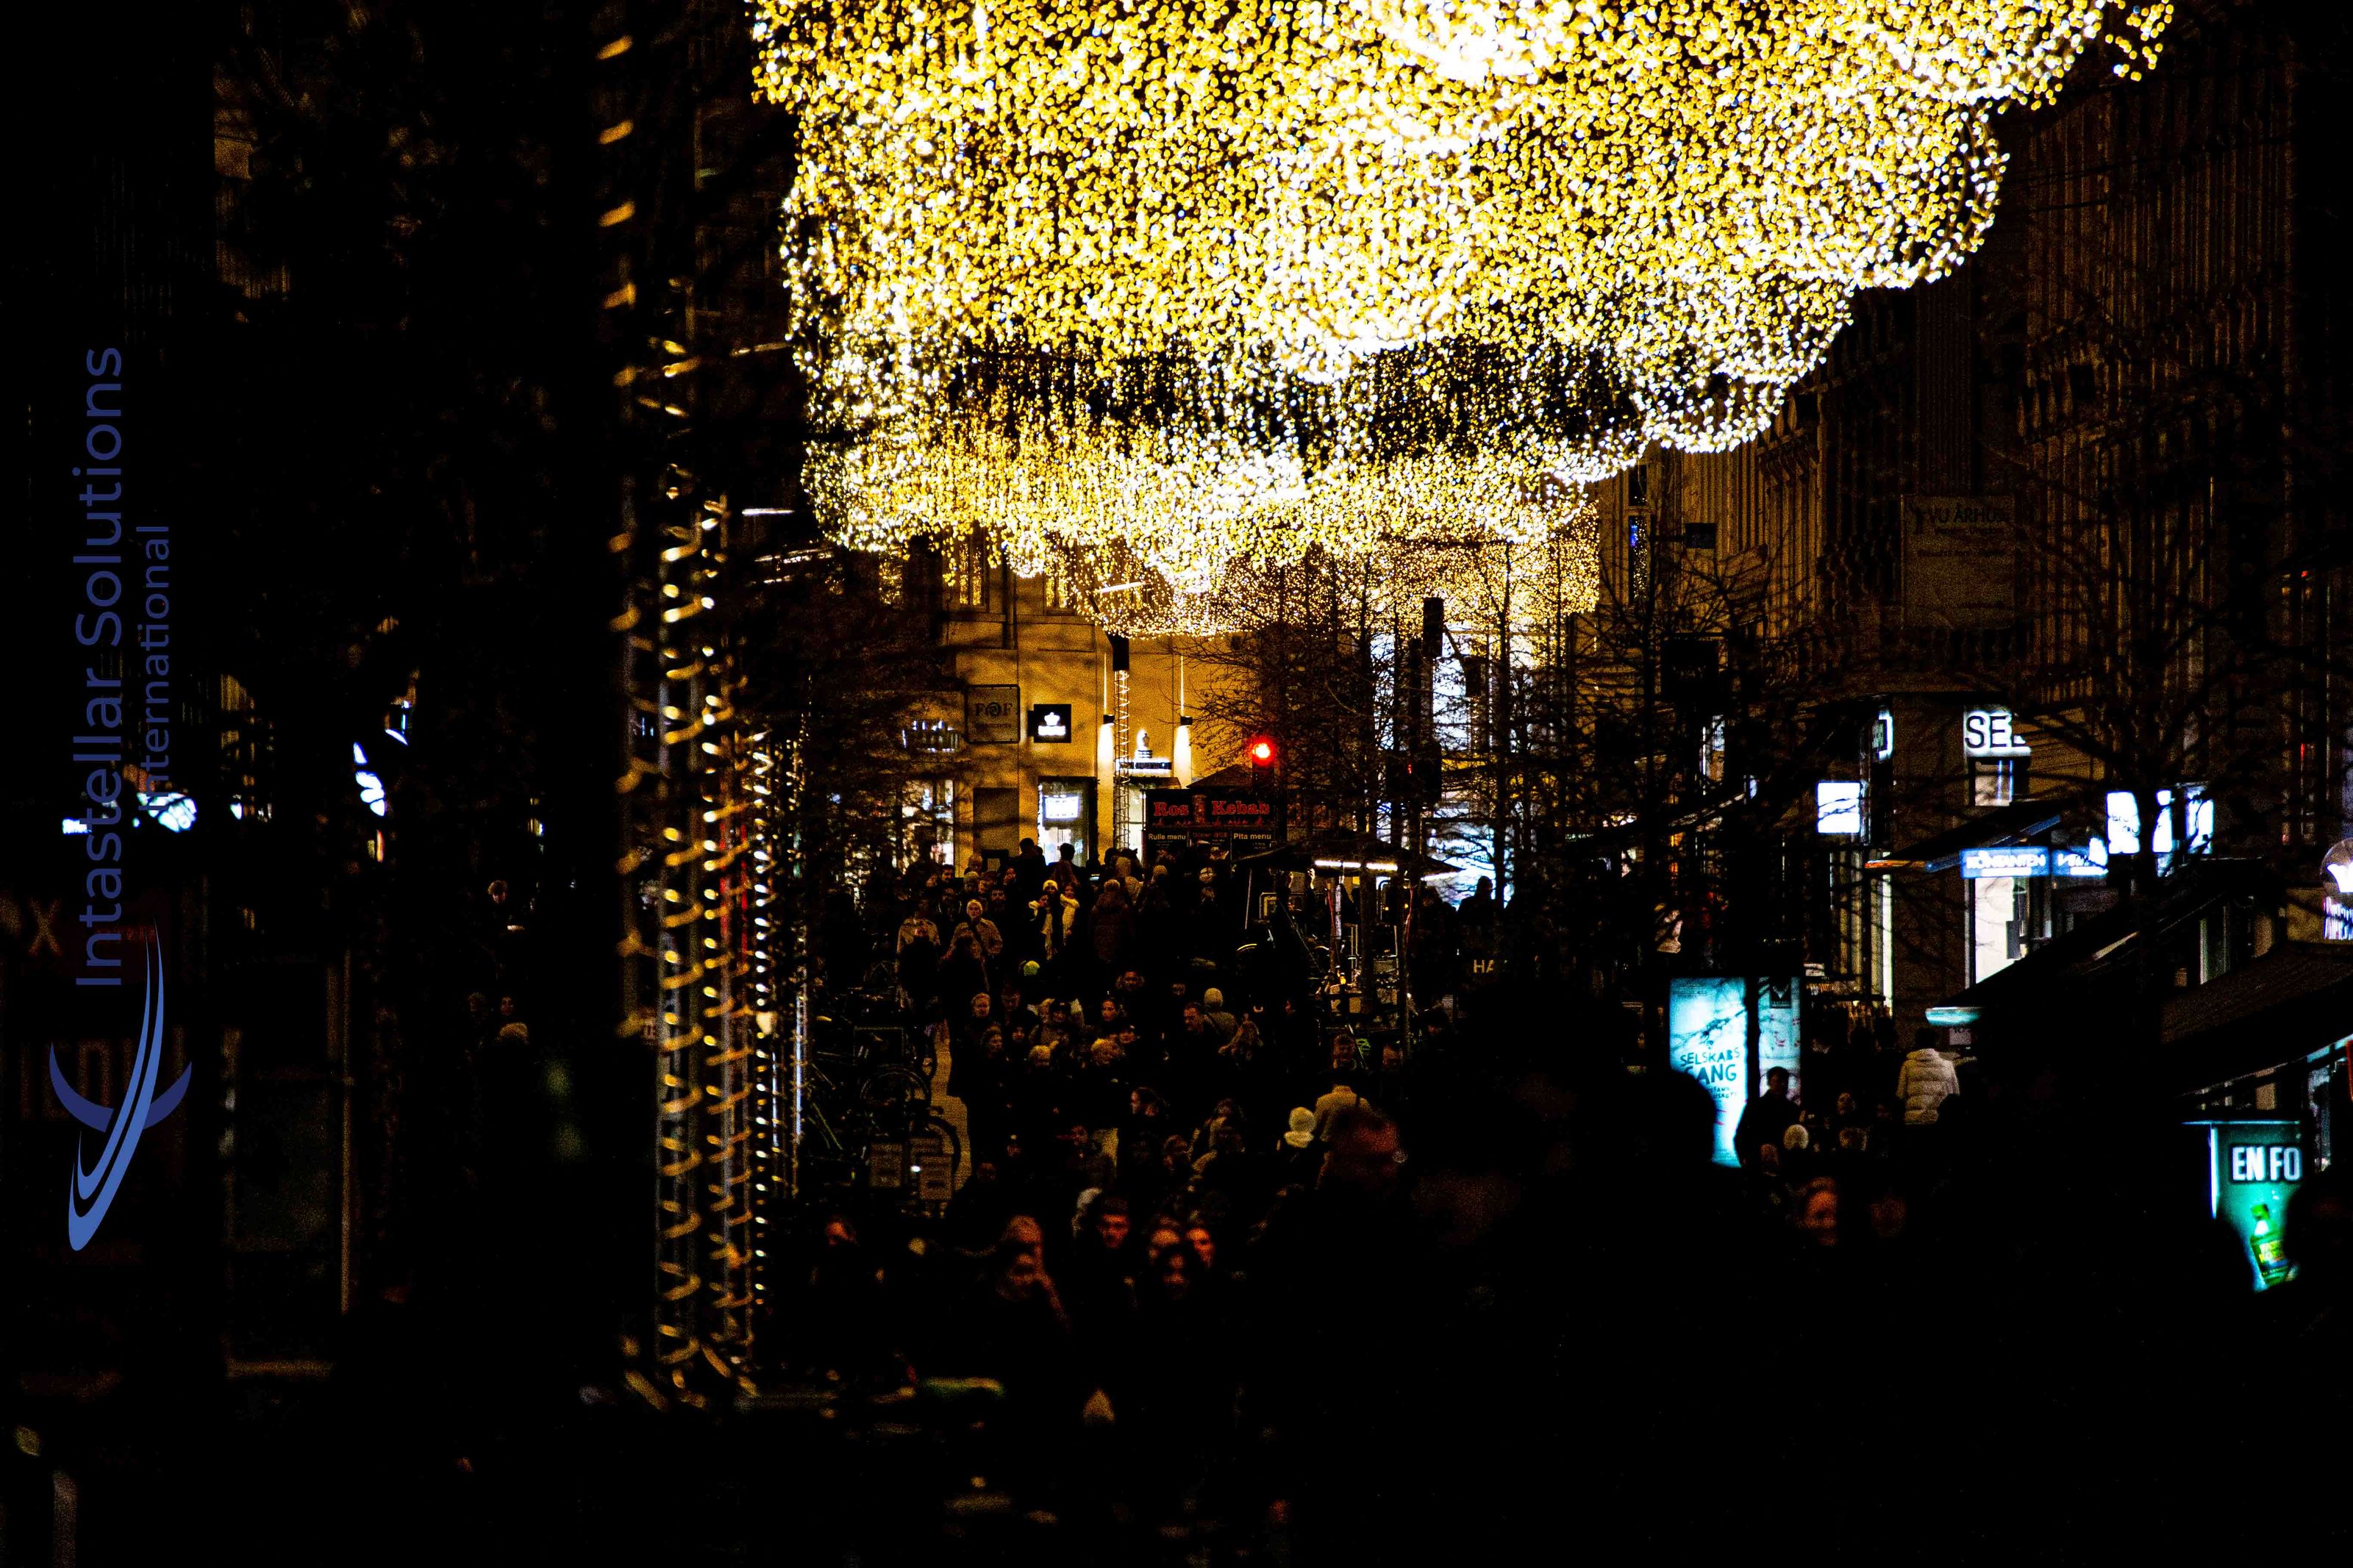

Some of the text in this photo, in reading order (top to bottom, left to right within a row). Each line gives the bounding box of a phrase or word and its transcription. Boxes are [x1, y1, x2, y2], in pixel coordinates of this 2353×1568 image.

[1153, 801, 1271, 816] Ros Kebab
[1679, 1047, 1740, 1067] SELSKABS
[1684, 1064, 1737, 1085] ANG
[2232, 1146, 2265, 1181] EN
